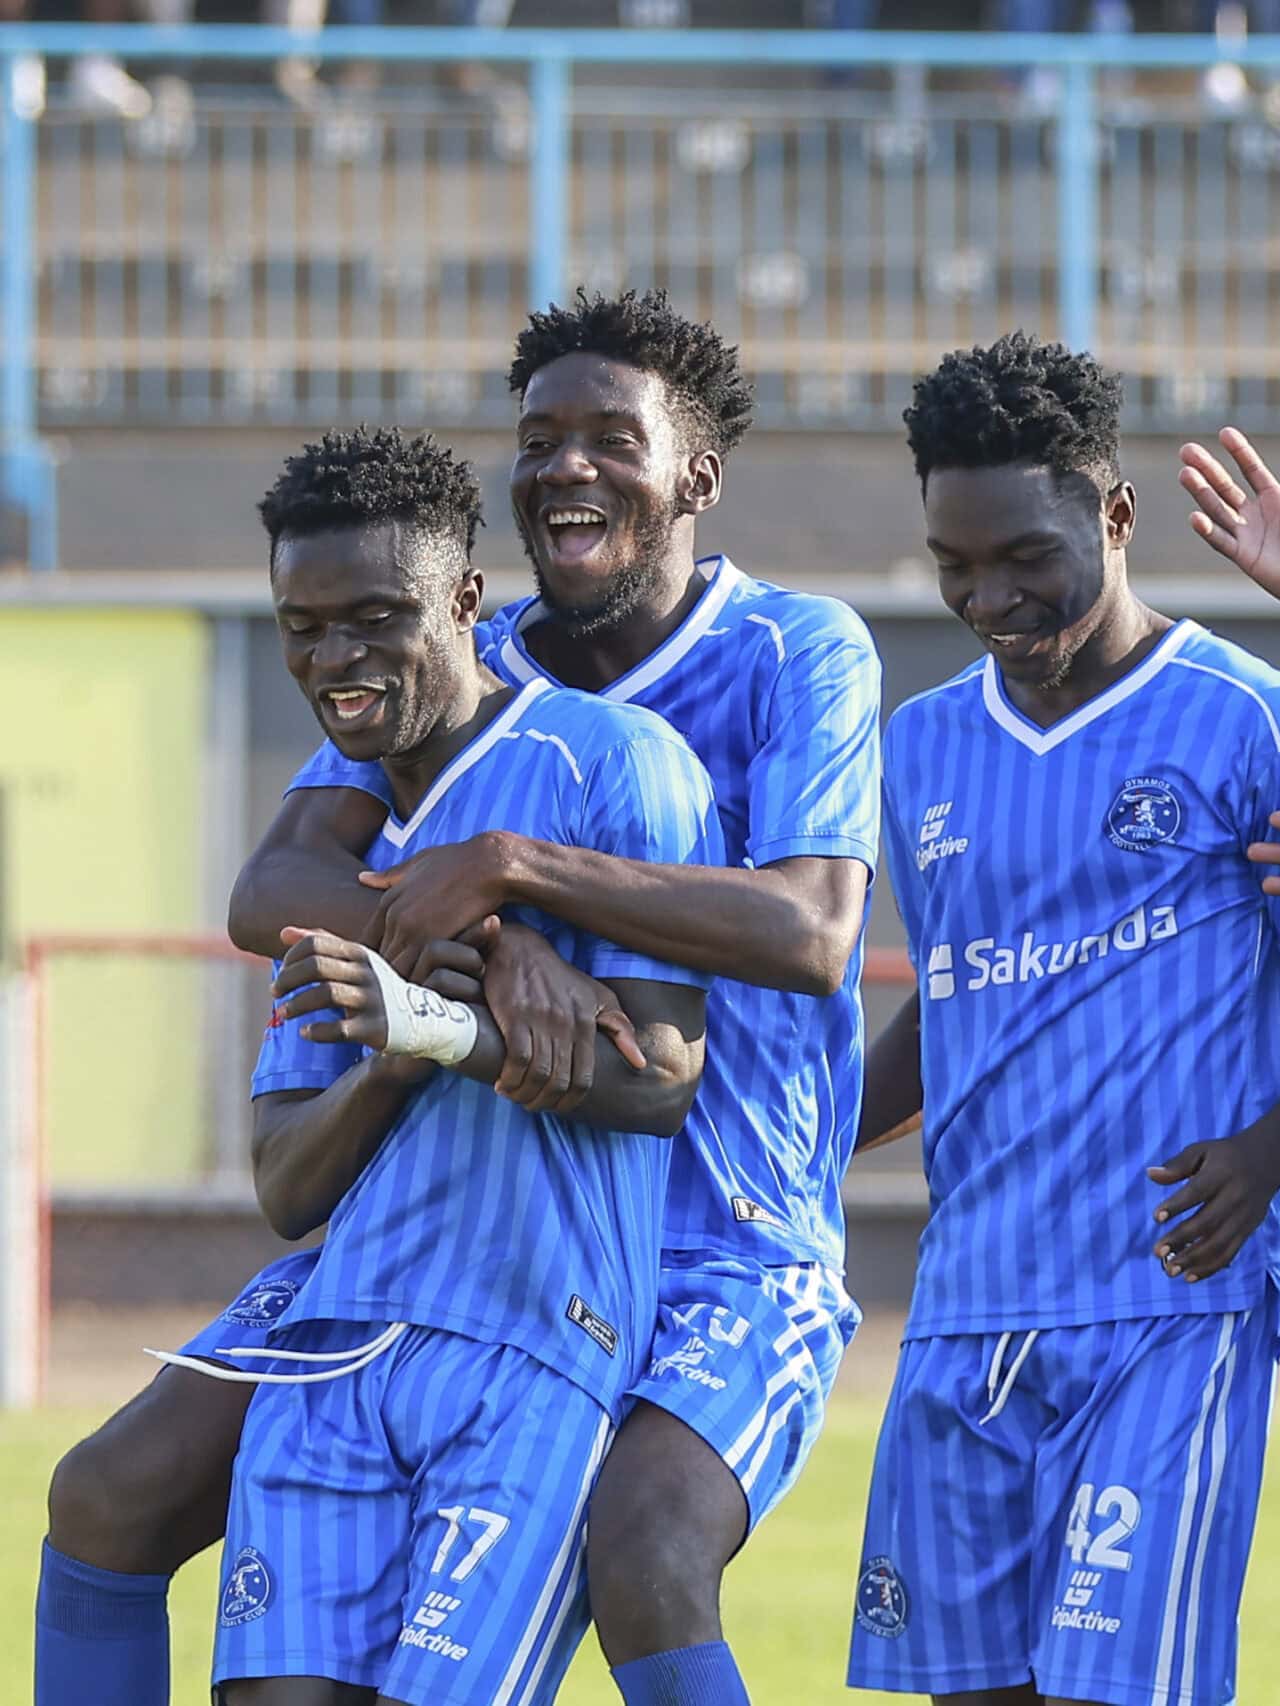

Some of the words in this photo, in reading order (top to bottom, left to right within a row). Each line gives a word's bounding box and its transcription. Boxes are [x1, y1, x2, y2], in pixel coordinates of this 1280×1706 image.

[1124, 778, 1171, 789] DYNAMOS
[963, 902, 1180, 991] Sakunda
[430, 1504, 511, 1583] 17
[1064, 1483, 1141, 1572] 42
